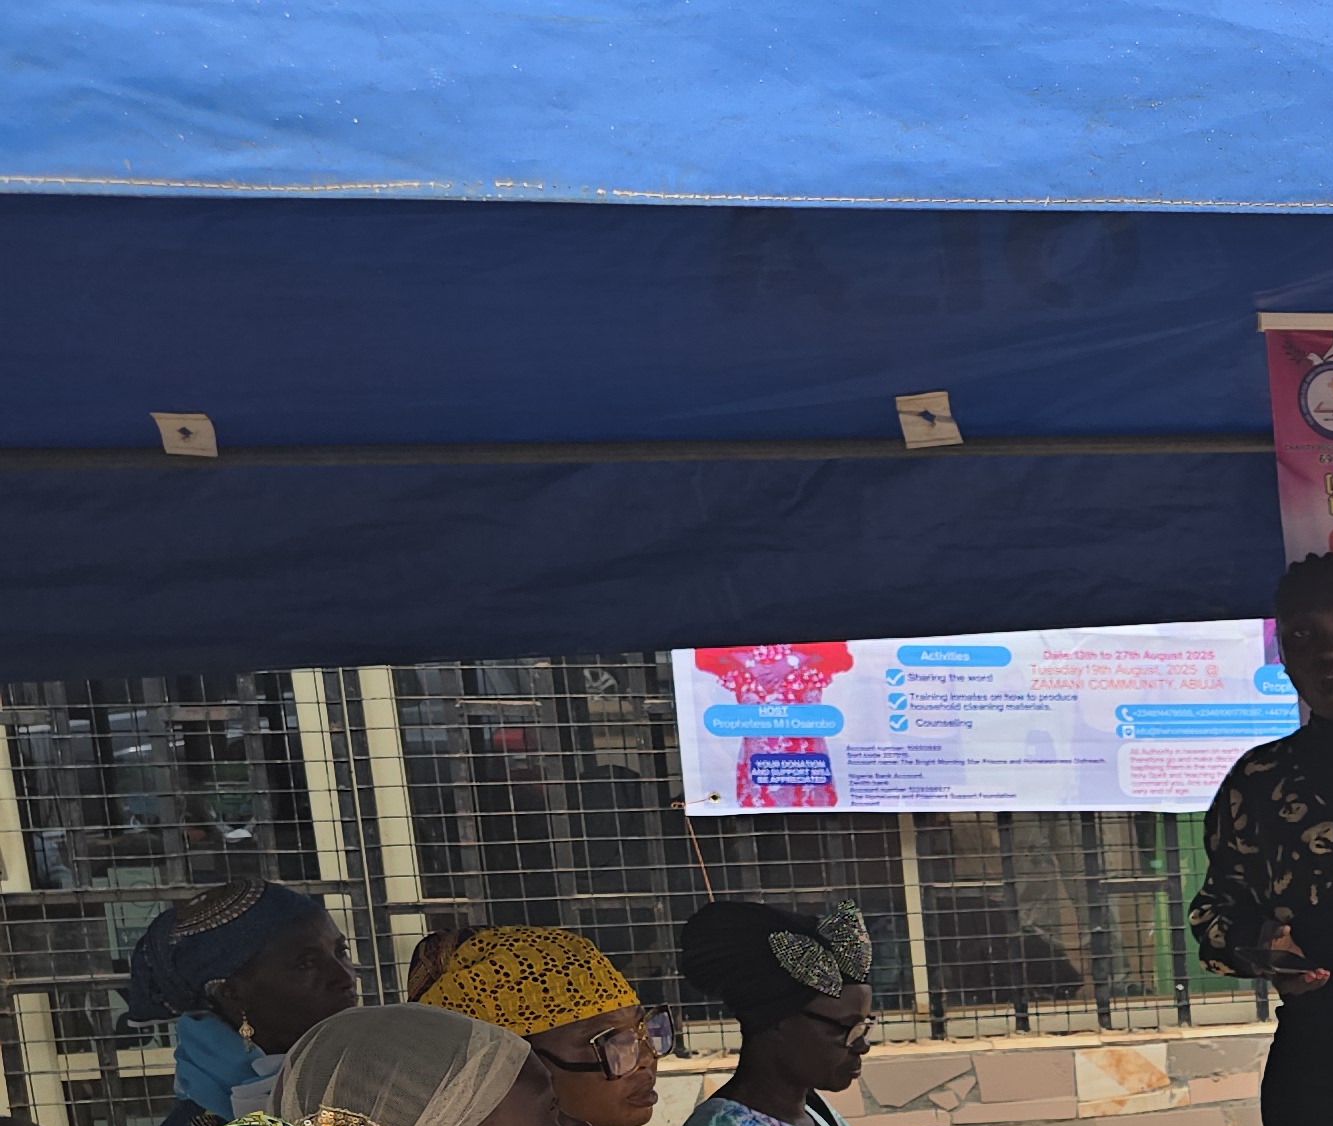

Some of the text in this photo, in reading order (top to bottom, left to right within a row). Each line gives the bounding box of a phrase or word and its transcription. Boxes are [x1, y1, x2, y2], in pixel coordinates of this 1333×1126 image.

[921, 651, 970, 661] Activities
[1143, 650, 1183, 662] August
[1167, 664, 1197, 675] 2025
[907, 673, 946, 684] Sharing
[949, 673, 965, 682] the
[1180, 679, 1225, 689] ABUJA
[909, 692, 947, 702] Training
[1038, 692, 1078, 702] produce
[758, 706, 788, 717] HOST
